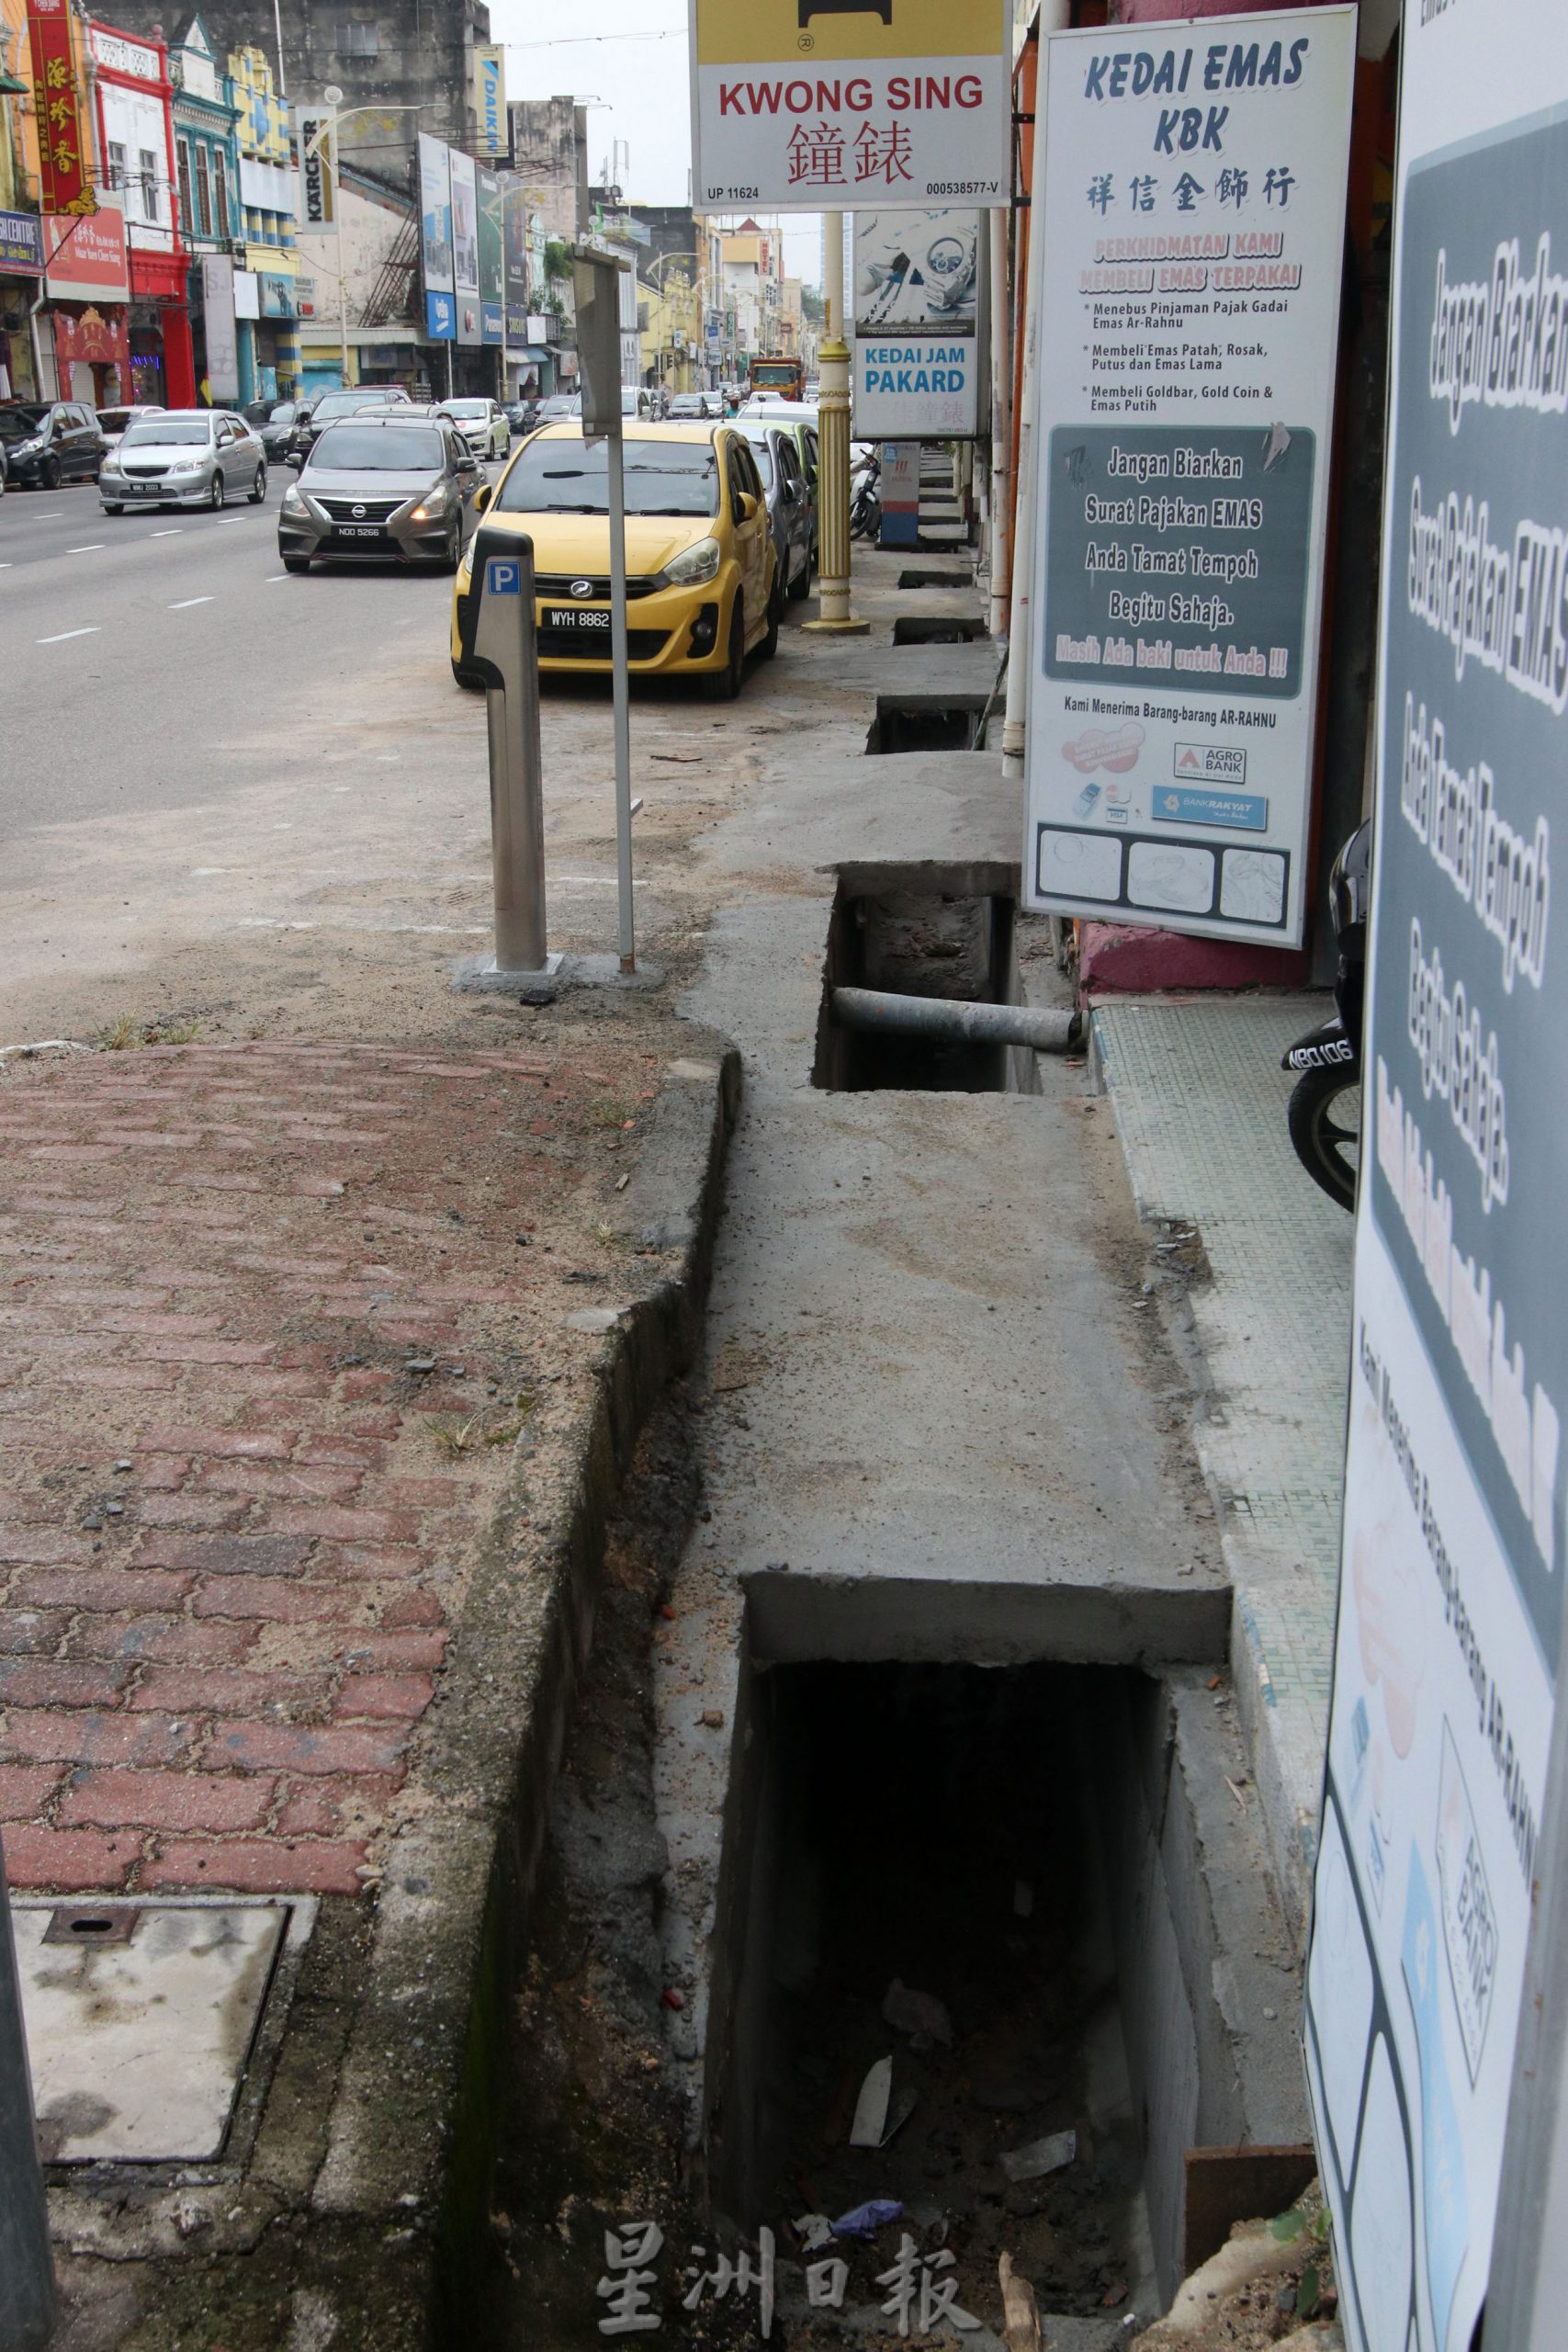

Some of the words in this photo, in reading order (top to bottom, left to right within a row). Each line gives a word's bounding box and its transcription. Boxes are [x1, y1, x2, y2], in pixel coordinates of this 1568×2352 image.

[1084, 48, 1192, 101] KEDAI
[1203, 38, 1308, 90] EMAS
[719, 79, 873, 116] KWONG
[886, 75, 983, 110] SING
[484, 79, 499, 153] DAIKIN
[1153, 106, 1229, 154] KBK
[786, 120, 914, 186] 鐘錶
[708, 187, 724, 199] UP
[728, 187, 759, 199] 11624
[926, 181, 998, 196] 000538577-V
[1086, 167, 1295, 214] 祥信金飾行
[7, 219, 35, 244] CENTRE
[1095, 234, 1227, 260] PERKHIDMATAN
[1234, 232, 1282, 257] KAMI
[1079, 267, 1152, 292] MEMBELI
[1159, 266, 1207, 290] EMAS
[1213, 264, 1300, 289] TERPAKAI
[1093, 302, 1146, 315] Menebus
[1150, 301, 1209, 317] Pinjaman
[1213, 300, 1247, 315] Pajak
[1252, 300, 1288, 313] Gadai
[1093, 316, 1123, 329] Emas
[1126, 316, 1183, 329] Ar-Rahnu
[1092, 344, 1145, 356] Membeli
[1147, 344, 1178, 356] Emas
[1227, 343, 1268, 358] Rosak,
[1430, 248, 1487, 435] Jangan
[866, 348, 921, 364] KEDAI
[926, 347, 964, 363] JAM
[1092, 357, 1126, 370] Putus
[1129, 357, 1152, 370] dan
[1156, 357, 1186, 370] Emas
[1190, 357, 1222, 370] Lama
[866, 369, 964, 393] PAKARD
[1091, 386, 1143, 399] Membeli
[1146, 386, 1197, 400] Goldbar,
[1201, 386, 1229, 399] Gold
[1233, 386, 1259, 398] Coin
[1263, 386, 1273, 398] &
[1091, 400, 1121, 412] Emas
[1124, 399, 1156, 412] Putih
[1109, 447, 1168, 483] Jangan
[1175, 447, 1243, 479] Biarkan
[1086, 495, 1134, 525] Surat
[1139, 496, 1206, 532] Pajakan
[1212, 499, 1262, 529] EMAS
[357, 528, 379, 537] 5266
[1086, 544, 1127, 572] Anda
[1132, 546, 1186, 574] Tamat
[1191, 548, 1258, 583] Tempoh
[495, 566, 513, 592] P
[552, 611, 575, 627] WYH
[579, 611, 609, 628] 8862
[1110, 591, 1165, 627] Begitu
[1169, 593, 1235, 630] Sahaja.
[1056, 634, 1099, 665] Masih
[1103, 637, 1133, 667] Ada
[1137, 639, 1171, 670] baki
[1175, 642, 1221, 673] untuk
[1224, 645, 1266, 676] Anda
[1064, 695, 1089, 713] Kami
[1092, 697, 1140, 717] Menerima
[1143, 702, 1217, 727] Barang-barang
[1220, 708, 1277, 729] AR-RAHNU
[1206, 750, 1243, 763] AGRO
[1206, 760, 1241, 773] BANK
[1487, 1679, 1536, 1895] AR-RAHN
